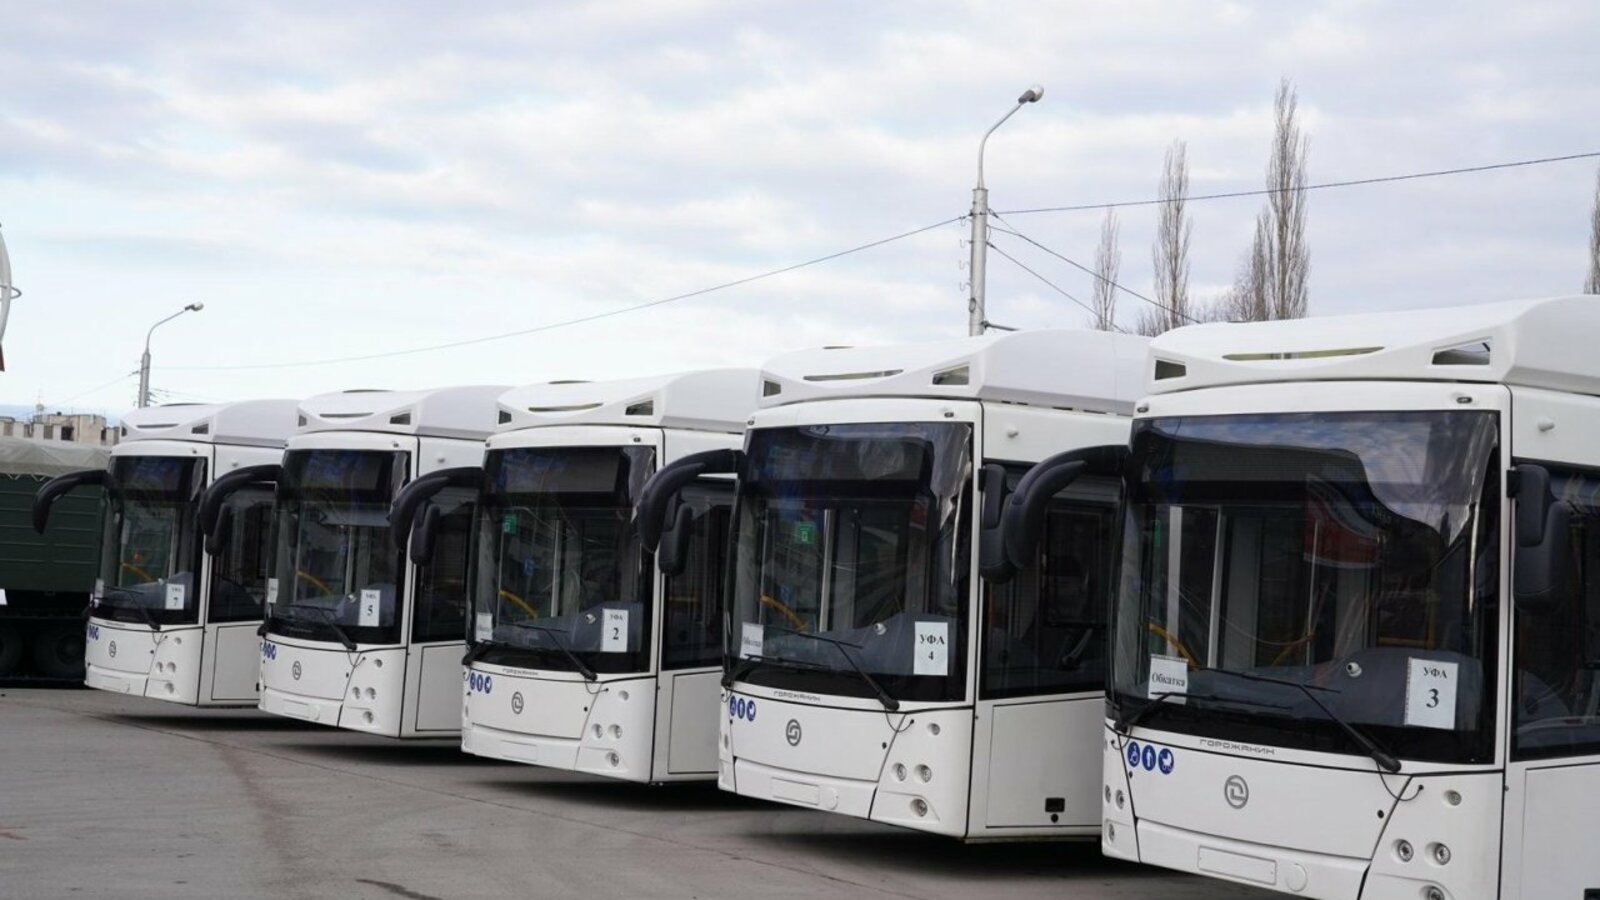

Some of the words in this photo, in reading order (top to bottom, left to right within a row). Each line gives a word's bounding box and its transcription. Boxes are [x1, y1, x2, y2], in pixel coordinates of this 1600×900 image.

[367, 604, 373, 616] 5
[612, 627, 620, 640] 2
[920, 633, 945, 645] УФА
[928, 651, 934, 661] 4
[1423, 666, 1448, 679] УФА
[1151, 672, 1186, 687] Обкатка
[1426, 688, 1440, 708] 3
[1200, 739, 1276, 755] ГОРОЖАНИН
